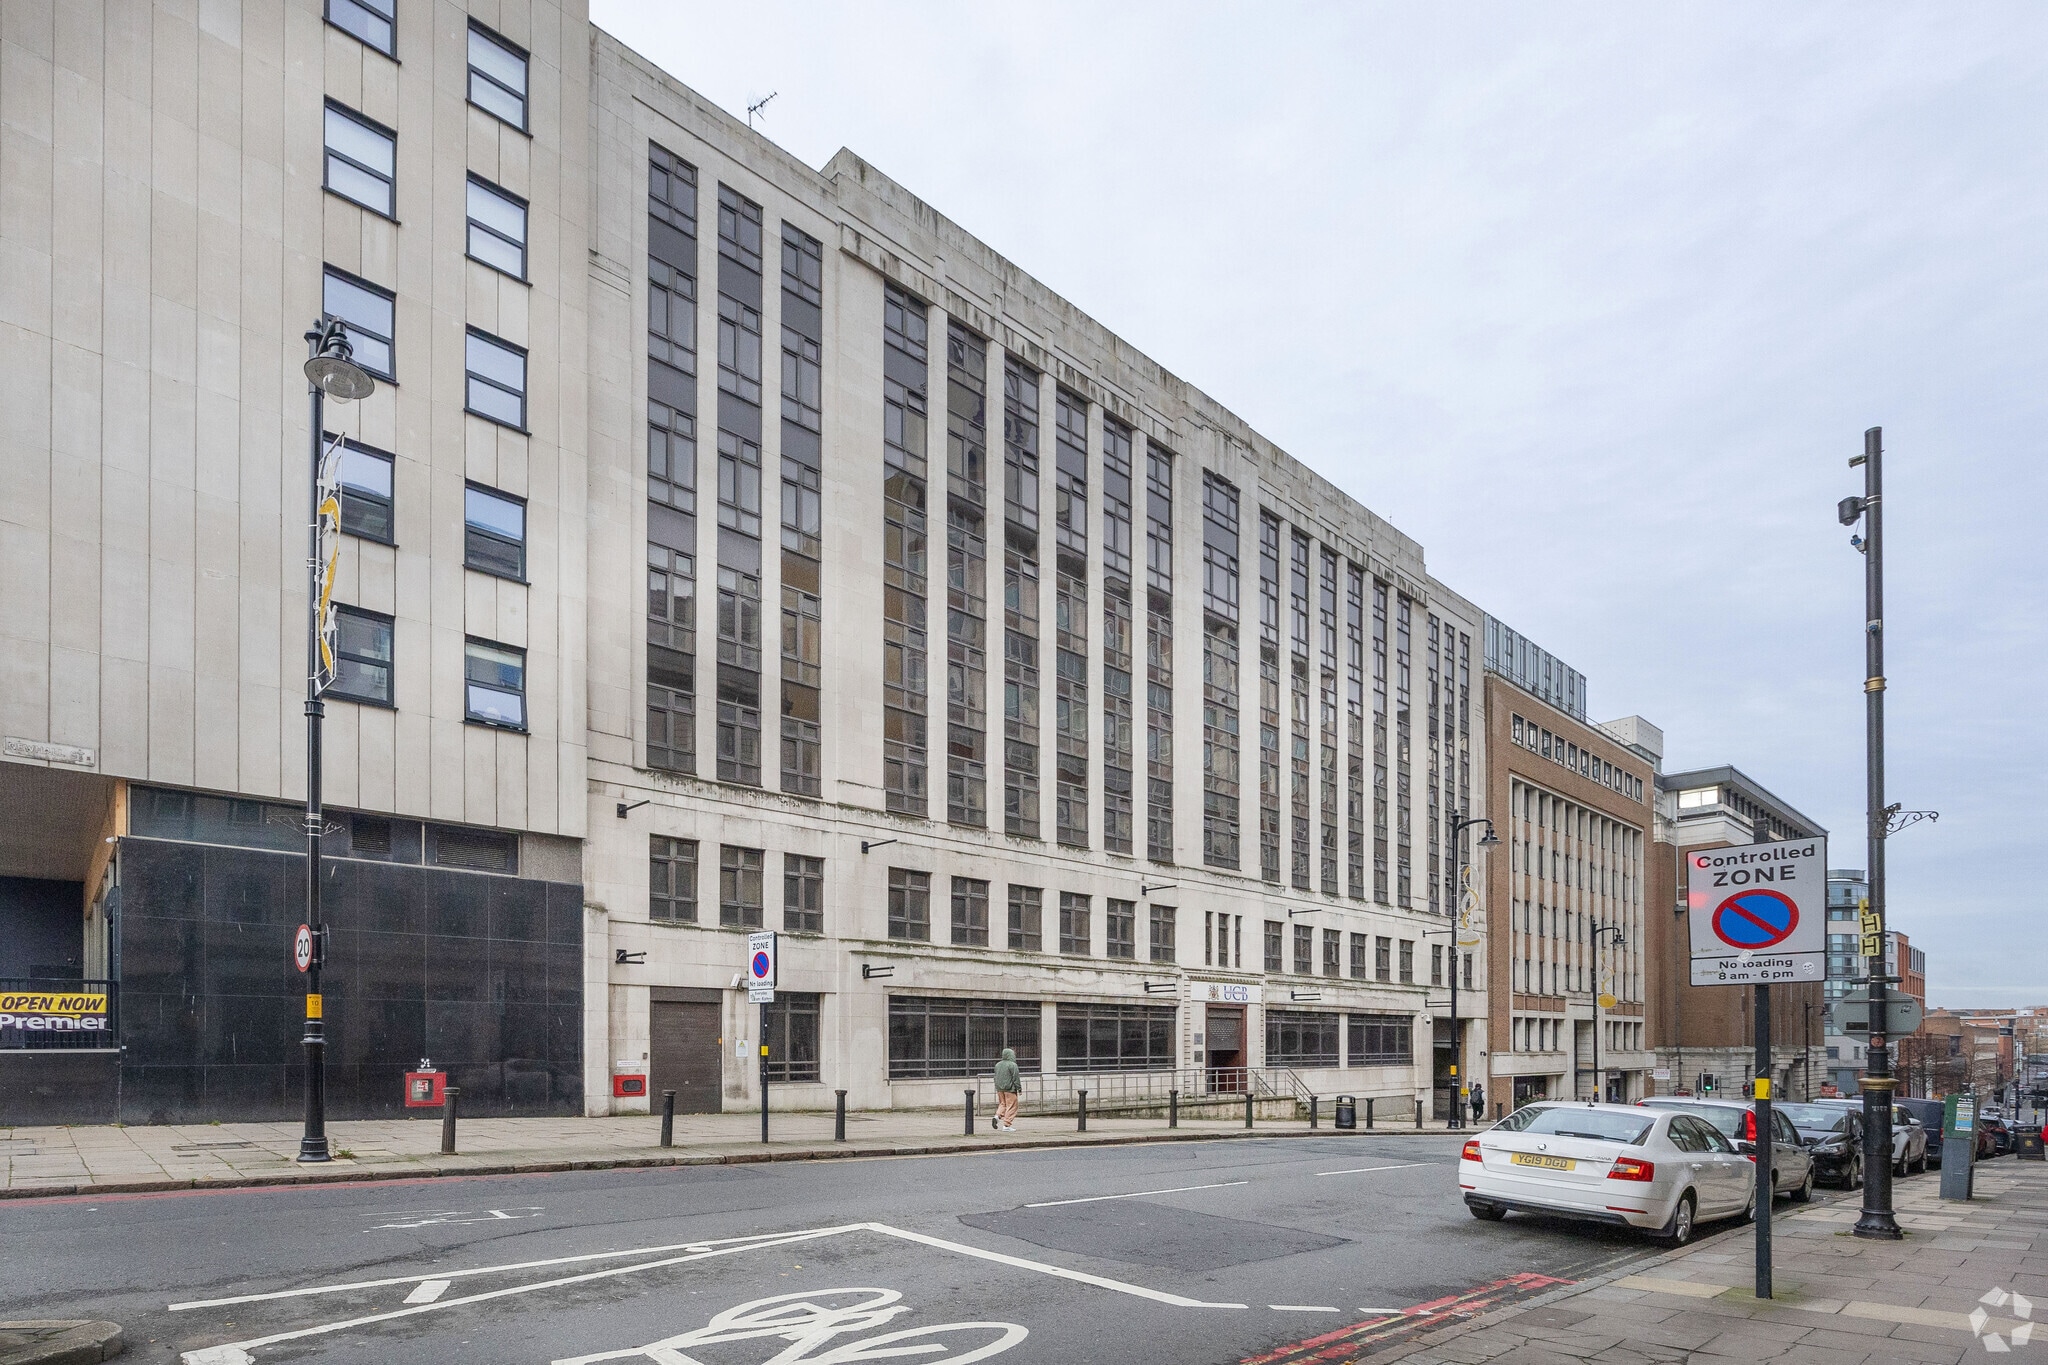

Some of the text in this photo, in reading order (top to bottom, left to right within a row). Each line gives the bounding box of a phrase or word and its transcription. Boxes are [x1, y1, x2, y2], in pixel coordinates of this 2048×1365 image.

[7, 741, 66, 758] NEWHALL
[1696, 844, 1815, 869] Controlled
[1713, 865, 1796, 887] ZONE
[749, 933, 773, 942] Controlled
[298, 938, 310, 957] 20
[752, 942, 769, 950] ZONE
[1719, 961, 1738, 969] No
[1718, 972, 1727, 980] 8
[1760, 970, 1769, 979] 6
[1772, 970, 1794, 979] pm
[1223, 985, 1248, 1001] UCB
[1, 996, 105, 1011] OPEN NOW
[0, 1014, 107, 1030] Premier
[1518, 1154, 1568, 1168] YG19 DGD
